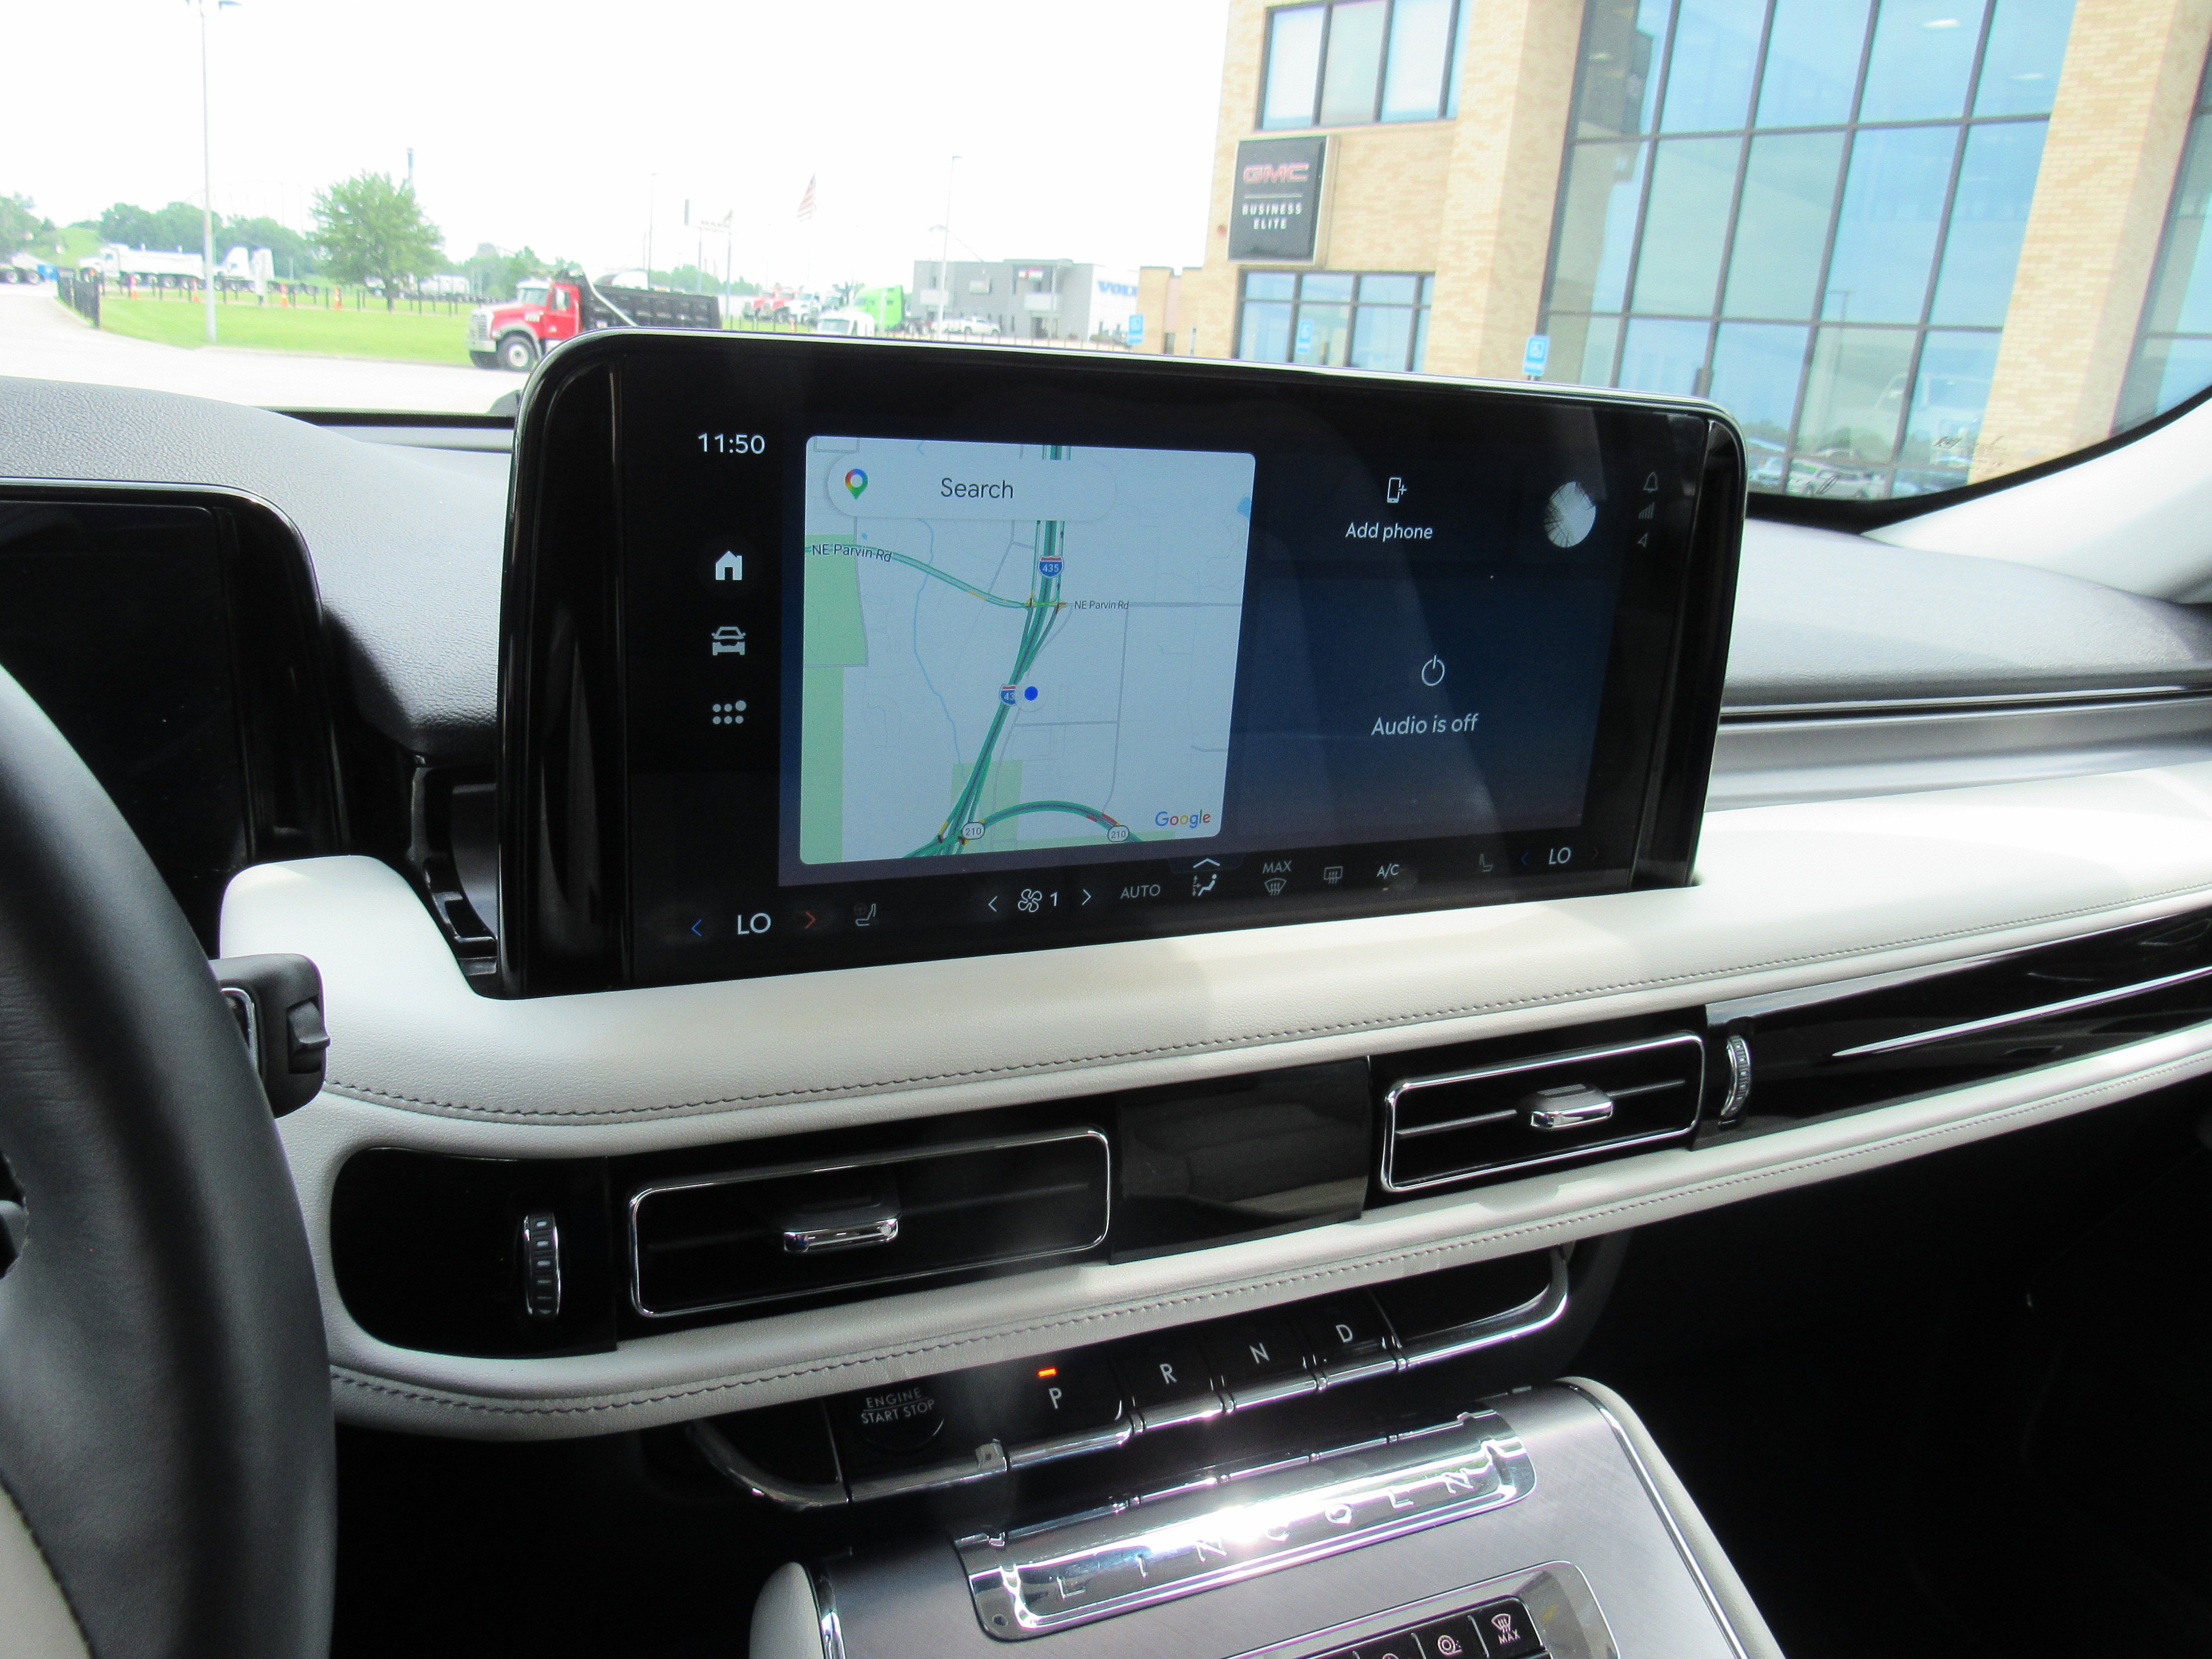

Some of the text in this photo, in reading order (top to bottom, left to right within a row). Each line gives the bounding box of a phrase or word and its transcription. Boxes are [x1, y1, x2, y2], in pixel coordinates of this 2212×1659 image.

[1243, 163, 1310, 183] GMC
[1242, 202, 1302, 215] BUSINESS
[1253, 217, 1287, 229] ELITE
[698, 433, 765, 455] 11:50
[940, 477, 1014, 500] Search
[1345, 522, 1433, 542] Add phone
[812, 543, 892, 562] NE Parvin Rd
[1042, 564, 1059, 573] 435
[1074, 600, 1129, 610] NE Parvin Rd
[1370, 712, 1479, 736] Audio is off
[1154, 810, 1211, 828] Google
[965, 827, 982, 836] 210
[1111, 830, 1126, 839] 210
[1549, 846, 1571, 865] LO
[1262, 860, 1292, 874] MAX
[1376, 863, 1400, 879] A/C
[1049, 892, 1058, 906] 1
[1120, 884, 1161, 899] AUTO
[737, 912, 771, 935] LO
[1335, 1324, 1353, 1343] D
[1250, 1343, 1270, 1364] N
[1159, 1363, 1177, 1384] R
[866, 1387, 922, 1409] ENGINE
[1048, 1388, 1062, 1409] P
[861, 1399, 935, 1425] START STOP
[1498, 1630, 1521, 1645] MAX
